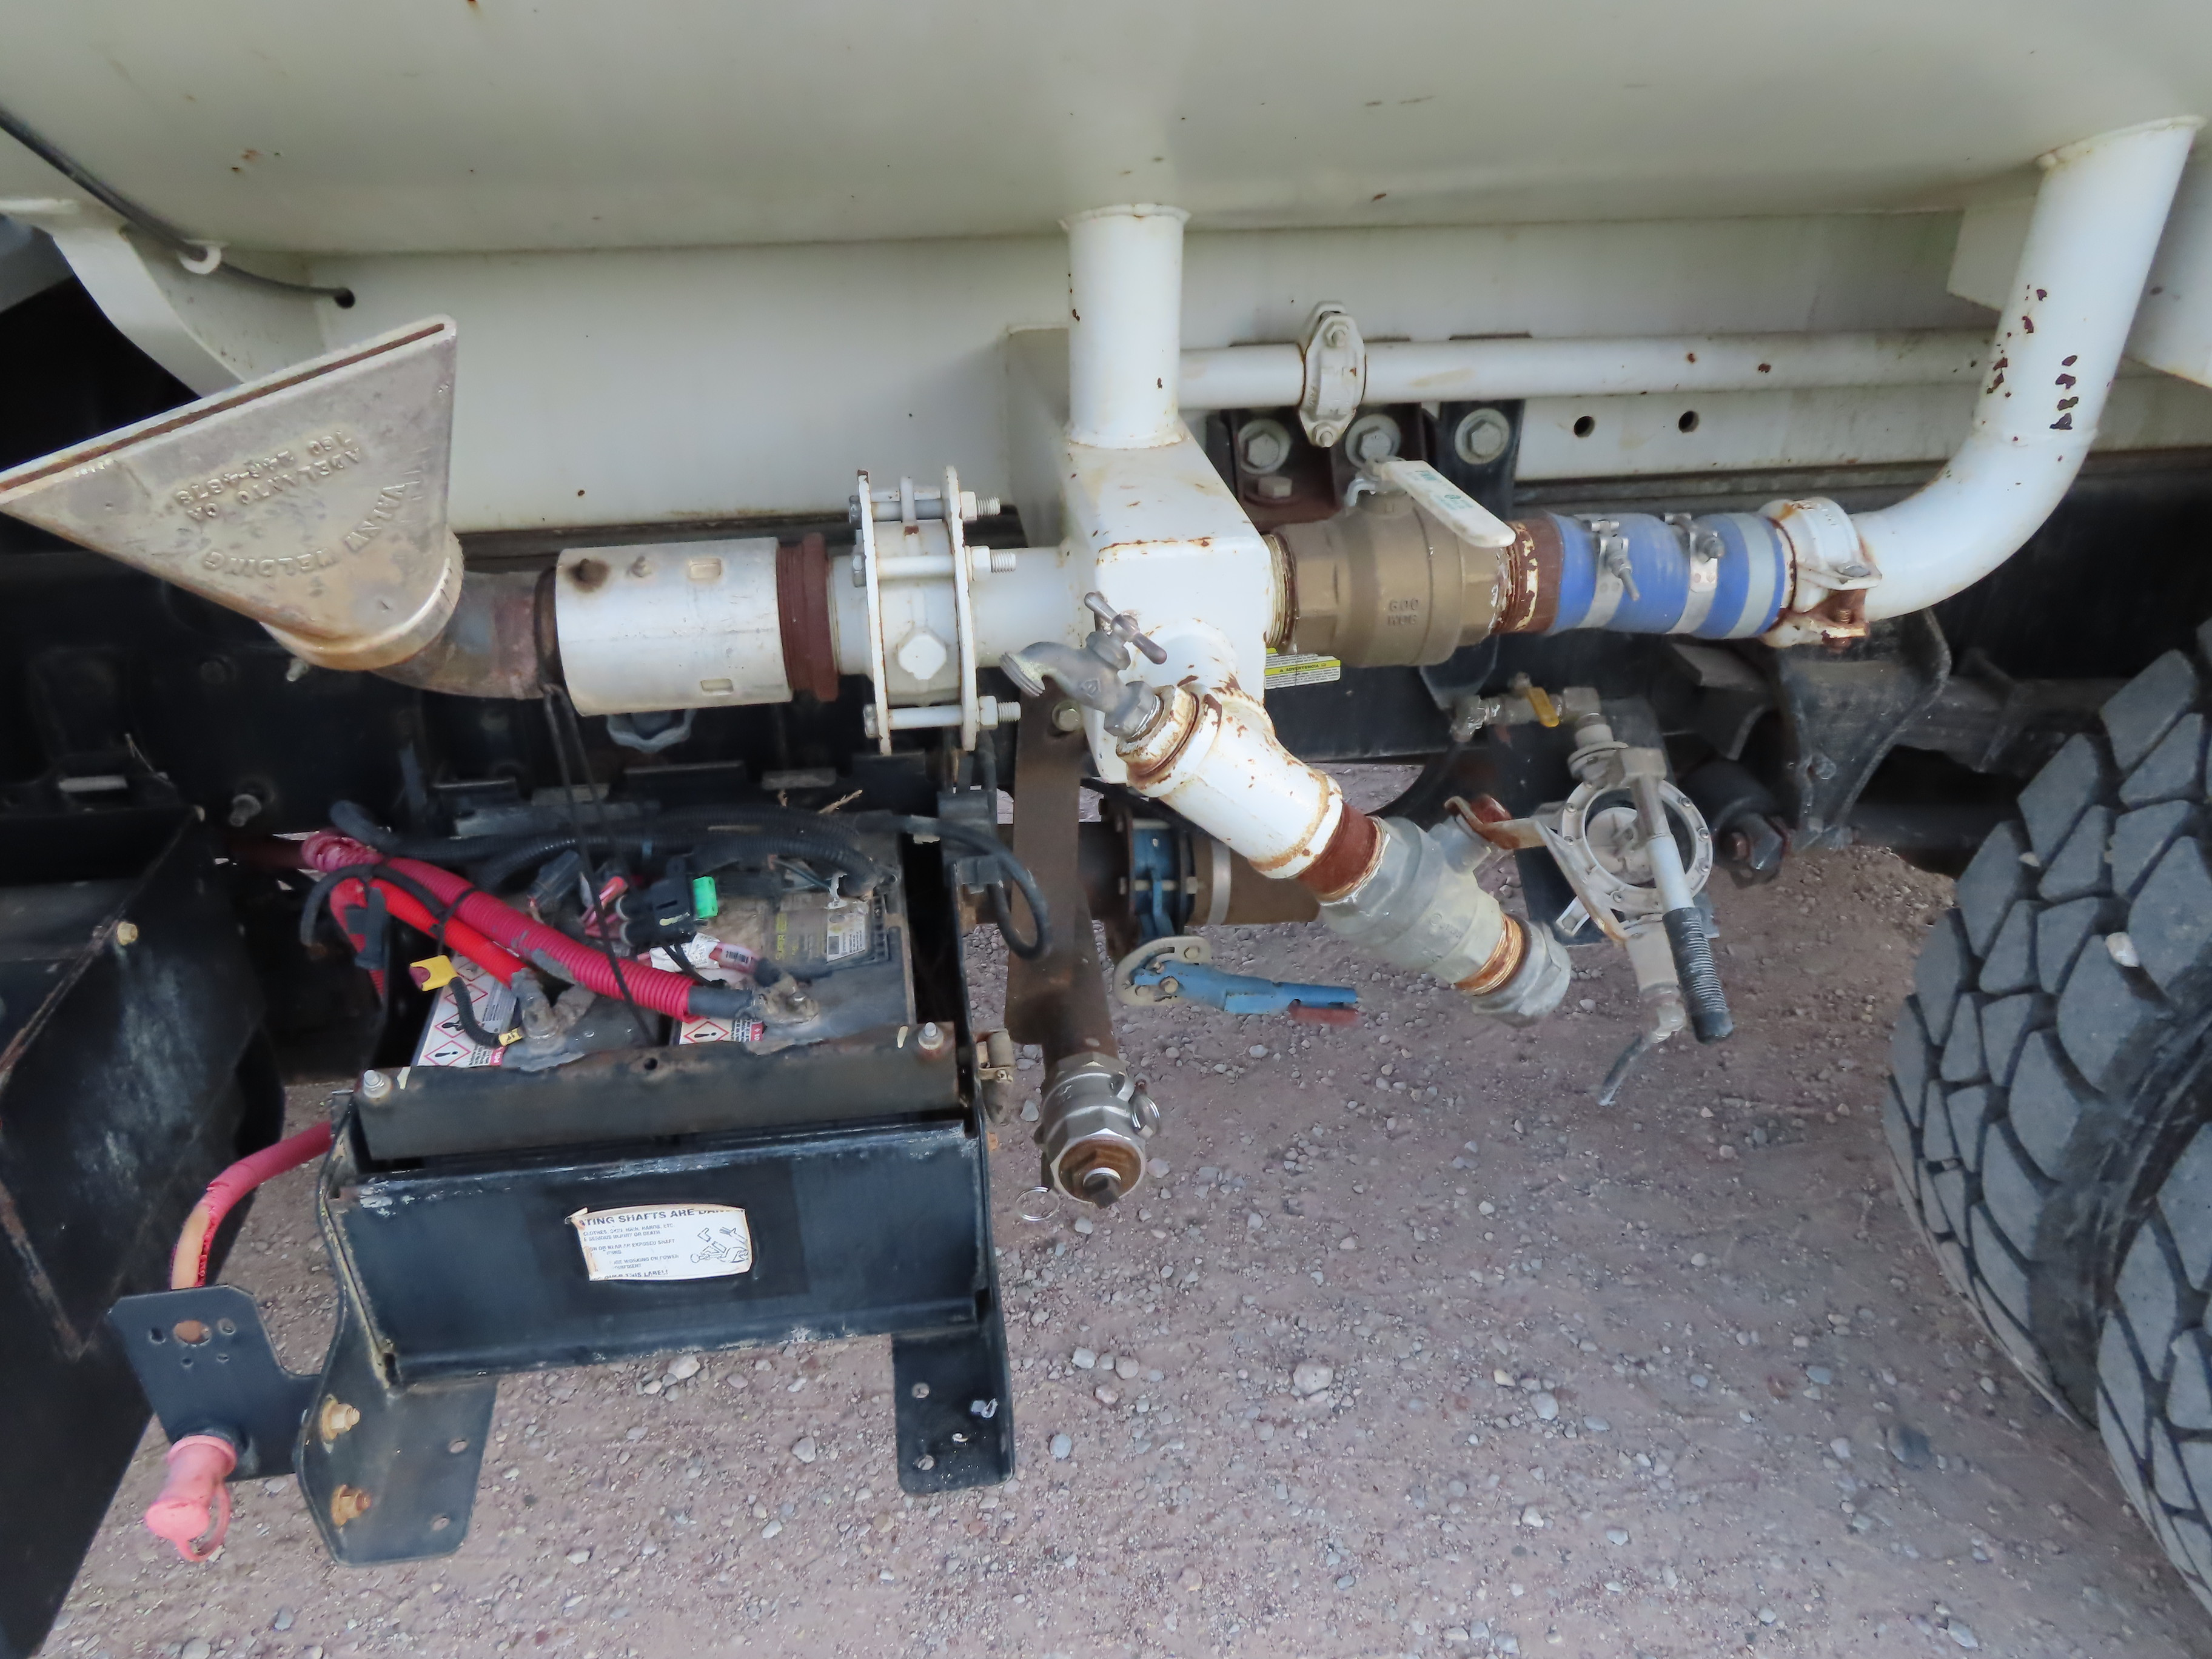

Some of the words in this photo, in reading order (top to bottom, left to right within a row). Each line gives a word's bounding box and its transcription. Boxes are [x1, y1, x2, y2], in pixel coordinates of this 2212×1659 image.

[202, 547, 340, 577] WELDING
[618, 1211, 666, 1222] SHAFTS
[670, 1208, 695, 1218] ARE
